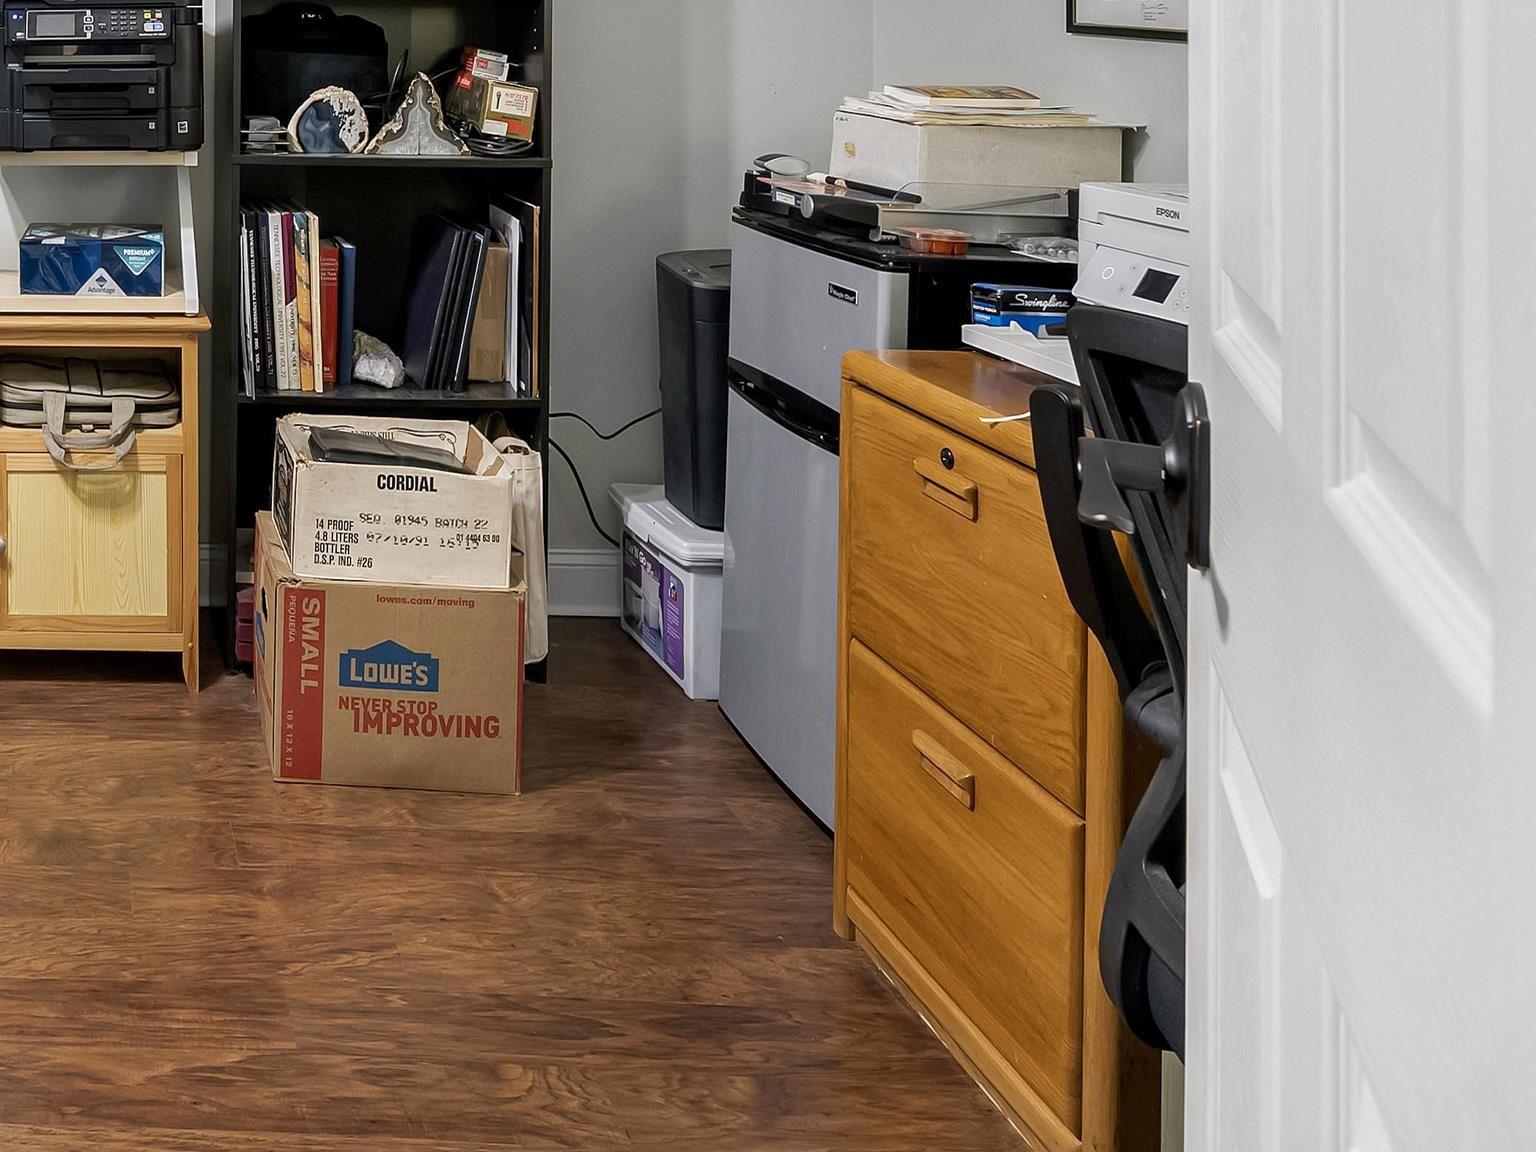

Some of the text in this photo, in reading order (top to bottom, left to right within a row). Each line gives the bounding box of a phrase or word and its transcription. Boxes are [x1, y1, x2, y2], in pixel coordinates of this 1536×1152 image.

[1156, 207, 1180, 220] EPSON
[275, 257, 283, 306] TECHNOLOGICAL
[87, 286, 116, 295] Advantage
[1010, 293, 1070, 311] Swingline
[377, 474, 438, 493] CORDIAL
[315, 518, 354, 531] 14 PROOF
[435, 517, 468, 529] BATCH
[474, 519, 488, 530] 22
[314, 532, 359, 545] 4.8 LITERS
[314, 543, 350, 555] BOTTLER
[314, 555, 373, 568] D.S.P. IND. #26
[376, 594, 475, 609] lowes.com/moving
[300, 596, 321, 695] SMALL
[338, 696, 438, 716] NEVER STOP
[353, 708, 500, 739] IMPROVING
[286, 733, 293, 745] 12
[285, 757, 293, 768] 12
